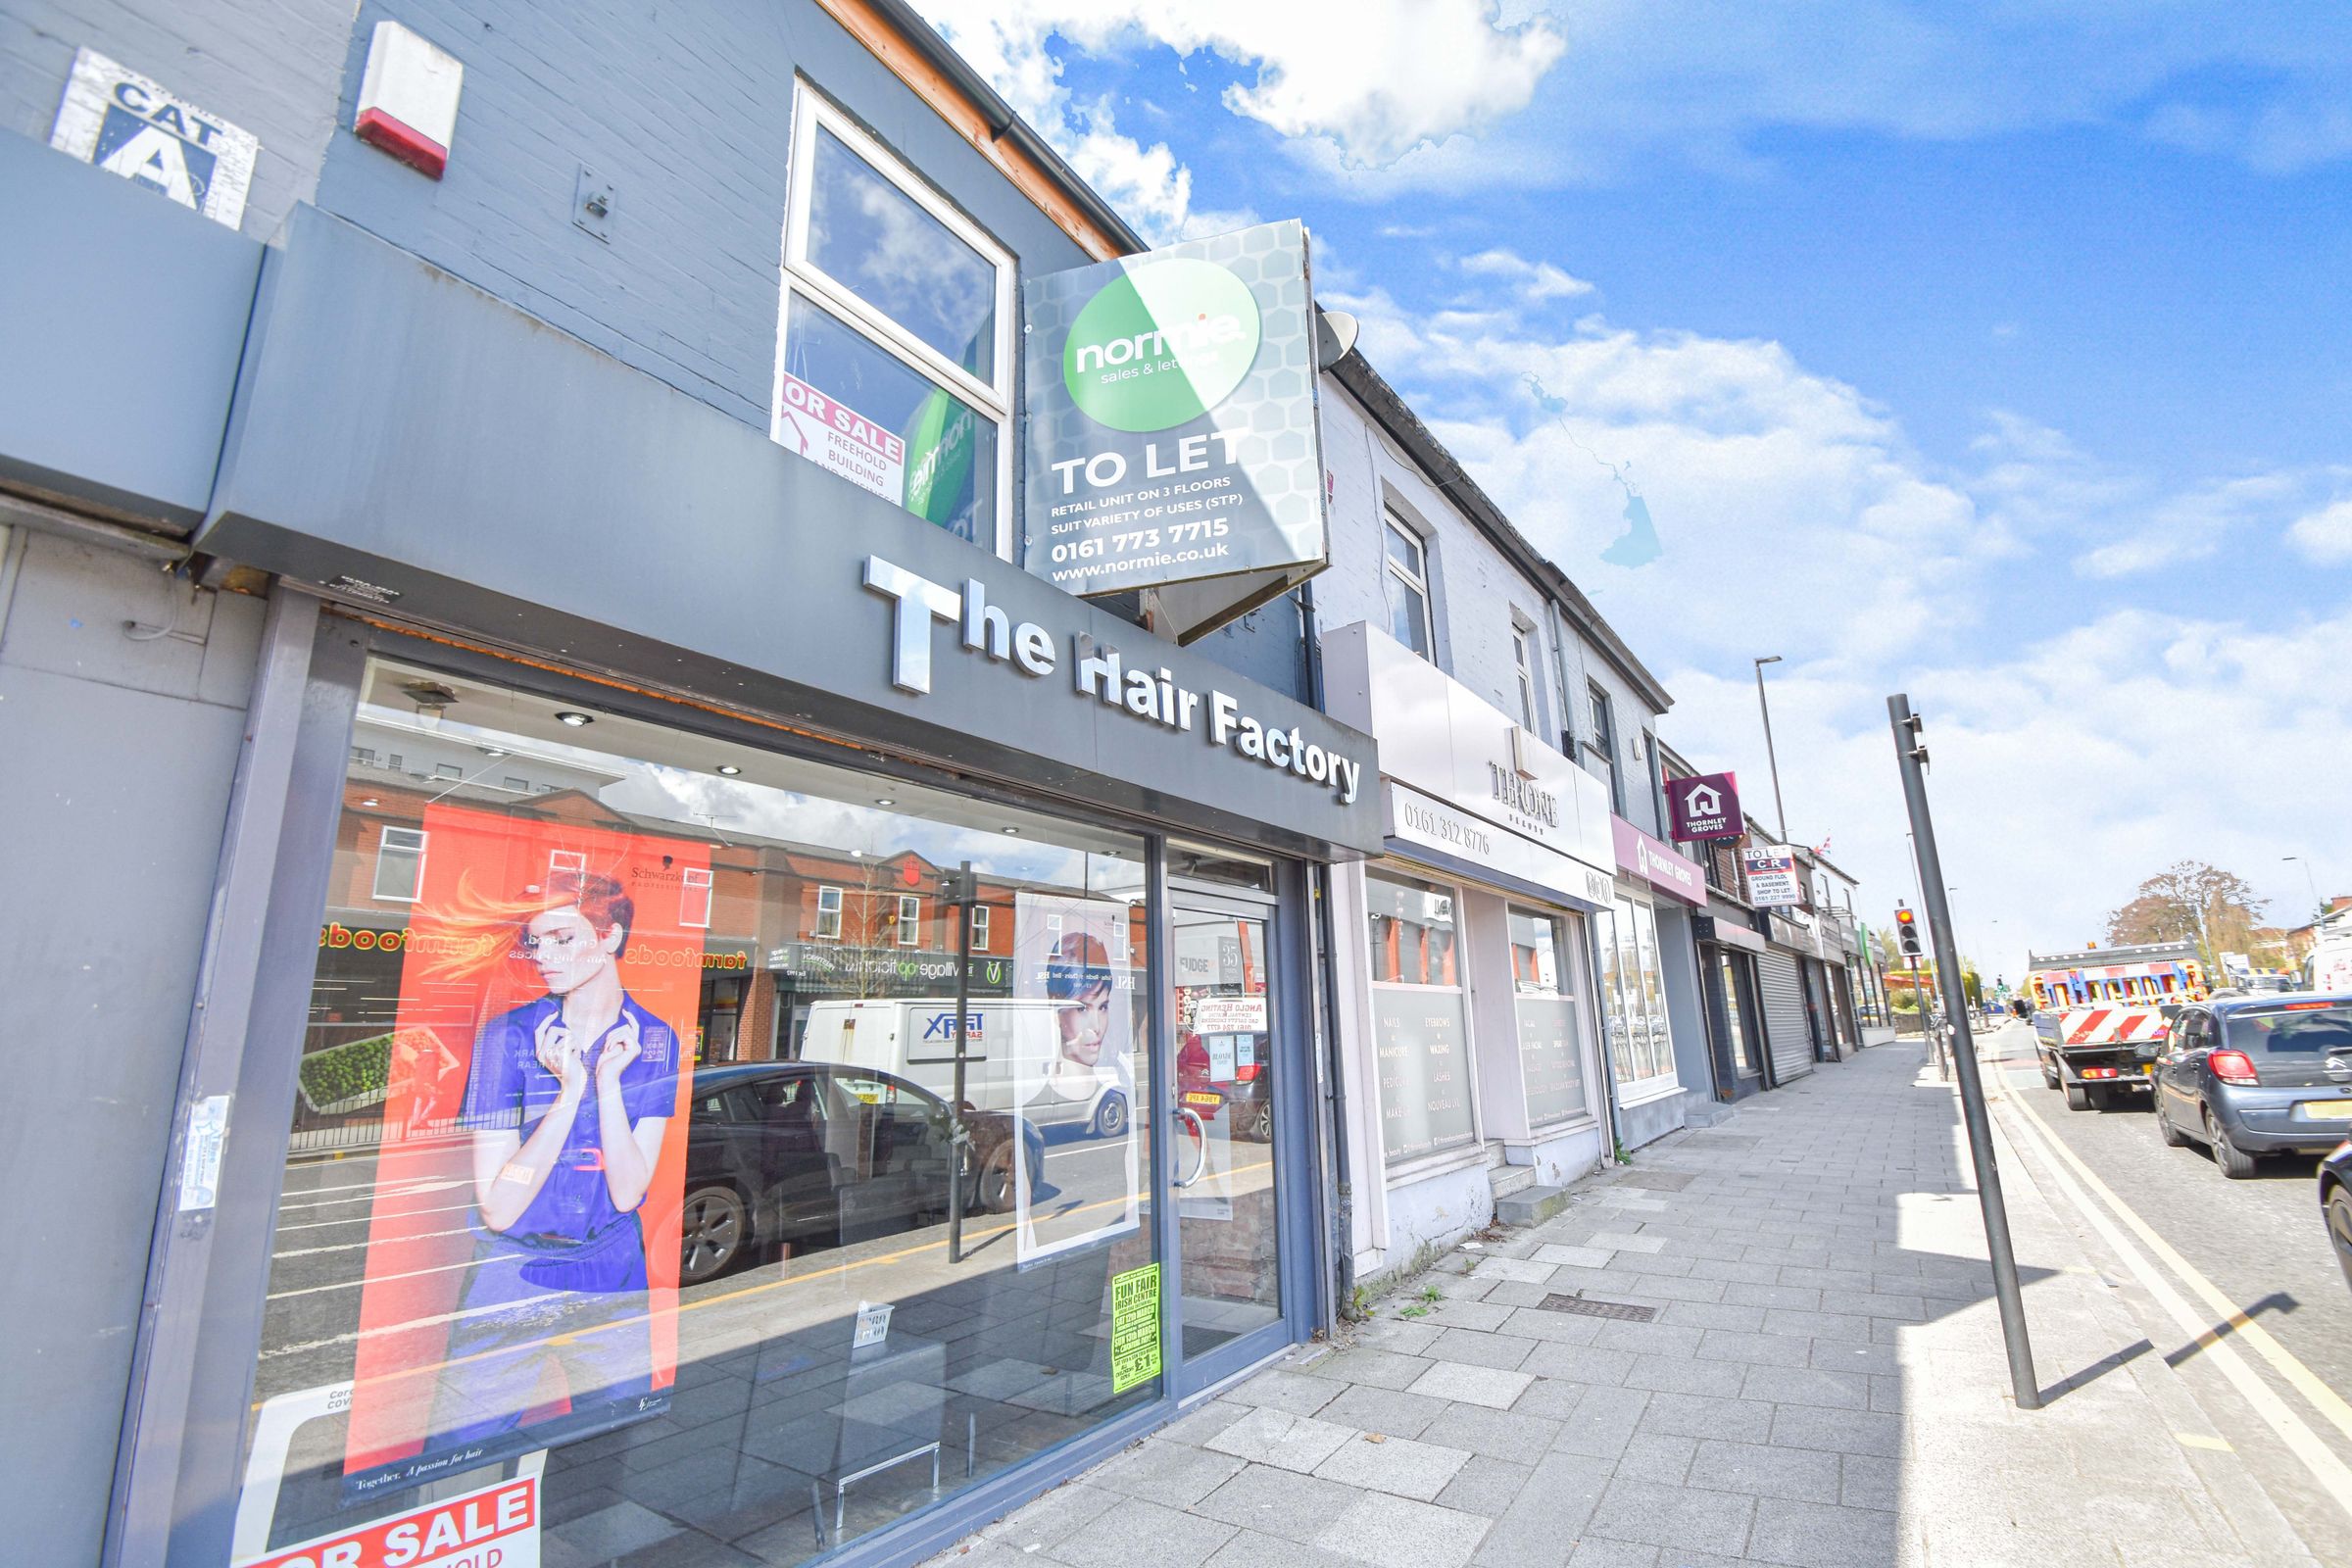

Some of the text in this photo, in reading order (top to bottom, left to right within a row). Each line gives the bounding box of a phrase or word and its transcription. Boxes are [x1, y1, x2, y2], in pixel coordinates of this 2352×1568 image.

[114, 81, 223, 146] CAT
[99, 124, 198, 211] A
[1101, 368, 1139, 384] sales
[1142, 364, 1153, 375] &
[784, 381, 902, 464] OR SALE
[827, 431, 887, 471] FREEHOLD
[828, 450, 884, 487] BUILDING
[1051, 426, 1250, 495] TO LET
[1051, 476, 1231, 517] RETAIL UNIT ON 3 FLOORS
[1051, 493, 1244, 535] SUIT VARIETY OF USES (STP)
[1051, 516, 1229, 563] 0161 773 7715
[1052, 542, 1230, 582] www.normie.co.uk
[862, 554, 1361, 806] The Hair Factory
[1487, 760, 1559, 828] THRONE
[1404, 802, 1490, 856] 0161 312 8776
[1686, 816, 1727, 828] THORNLEY
[1690, 823, 1724, 833] GROVES
[1647, 850, 1692, 887] THORNLEY GROVES
[1744, 850, 1762, 859] TO
[1383, 1017, 1400, 1028] NAILS
[1115, 1281, 1134, 1301] FUN
[1135, 1275, 1156, 1295] FAIR
[1115, 1295, 1133, 1311] IRISH
[1133, 1288, 1157, 1304] CENTRE
[1134, 1353, 1151, 1372] £1
[406, 1466, 415, 1477] A
[415, 1458, 449, 1476] passion
[448, 1452, 464, 1466] for
[465, 1446, 483, 1460] hair
[383, 1486, 530, 1568] SALE
